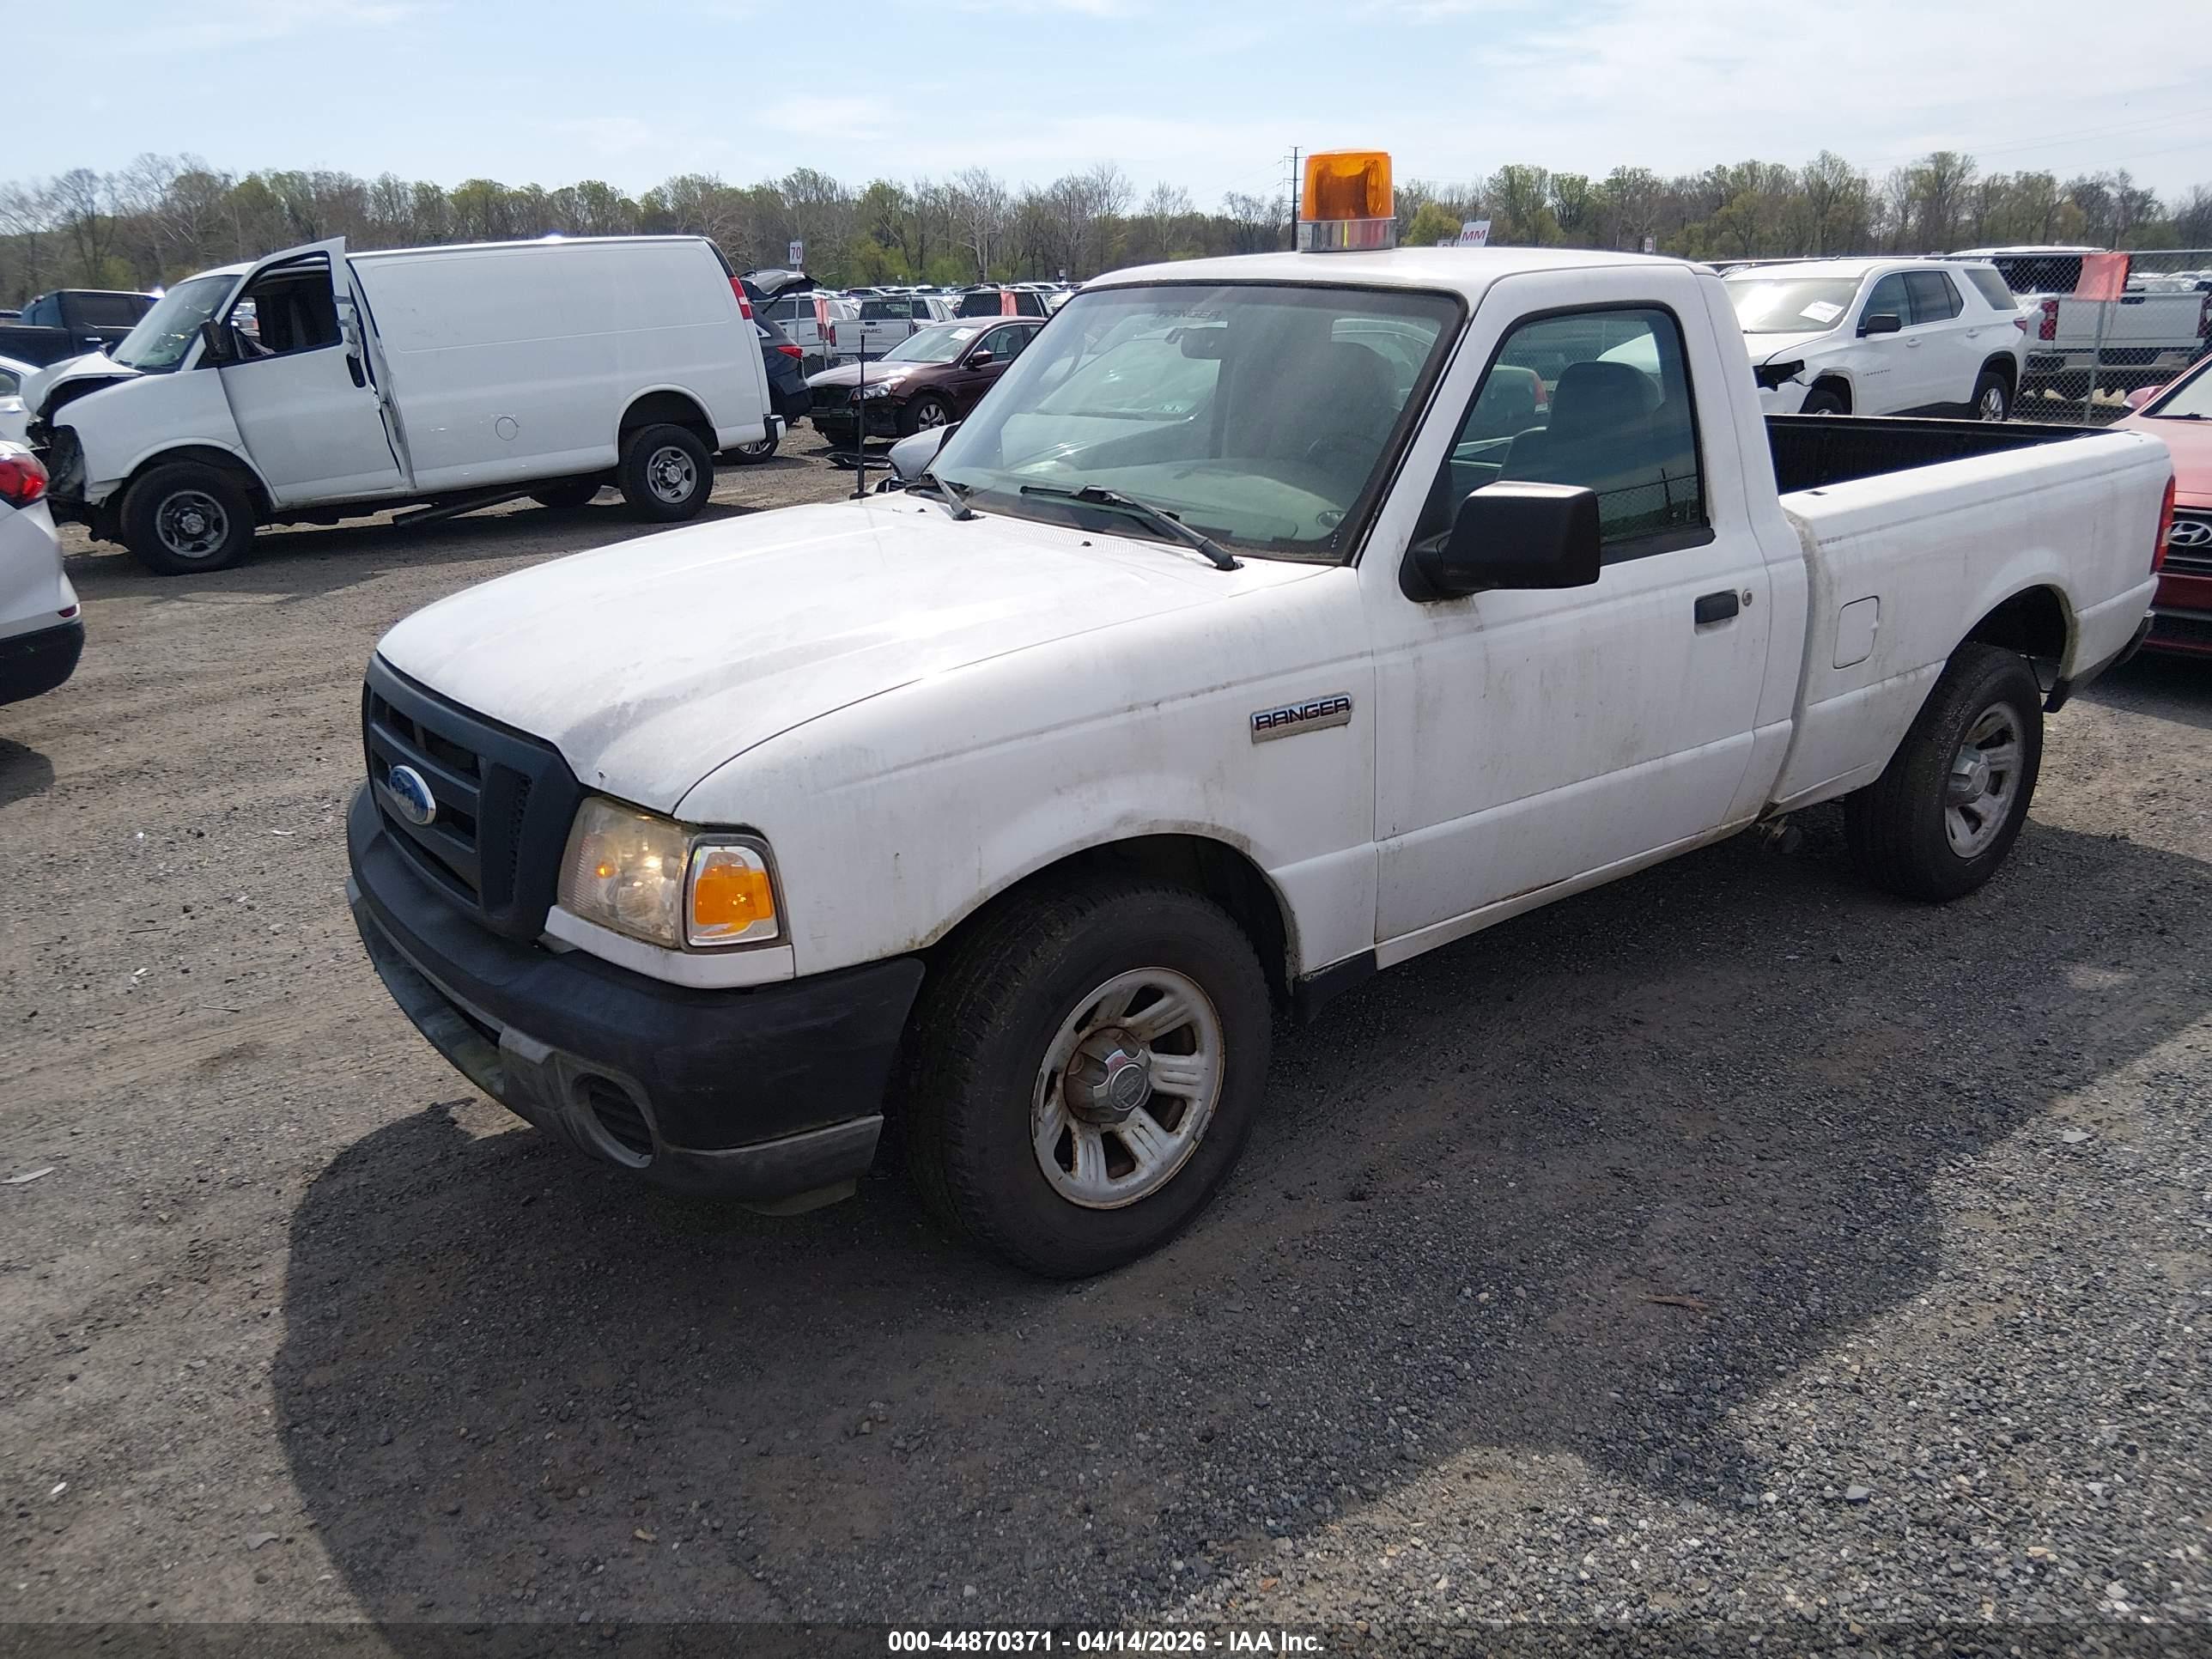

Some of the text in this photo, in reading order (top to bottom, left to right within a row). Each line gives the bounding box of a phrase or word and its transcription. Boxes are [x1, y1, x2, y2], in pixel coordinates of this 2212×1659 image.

[1462, 229, 1486, 242] MM
[790, 246, 802, 259] 70
[1255, 697, 1352, 731] RANGER
